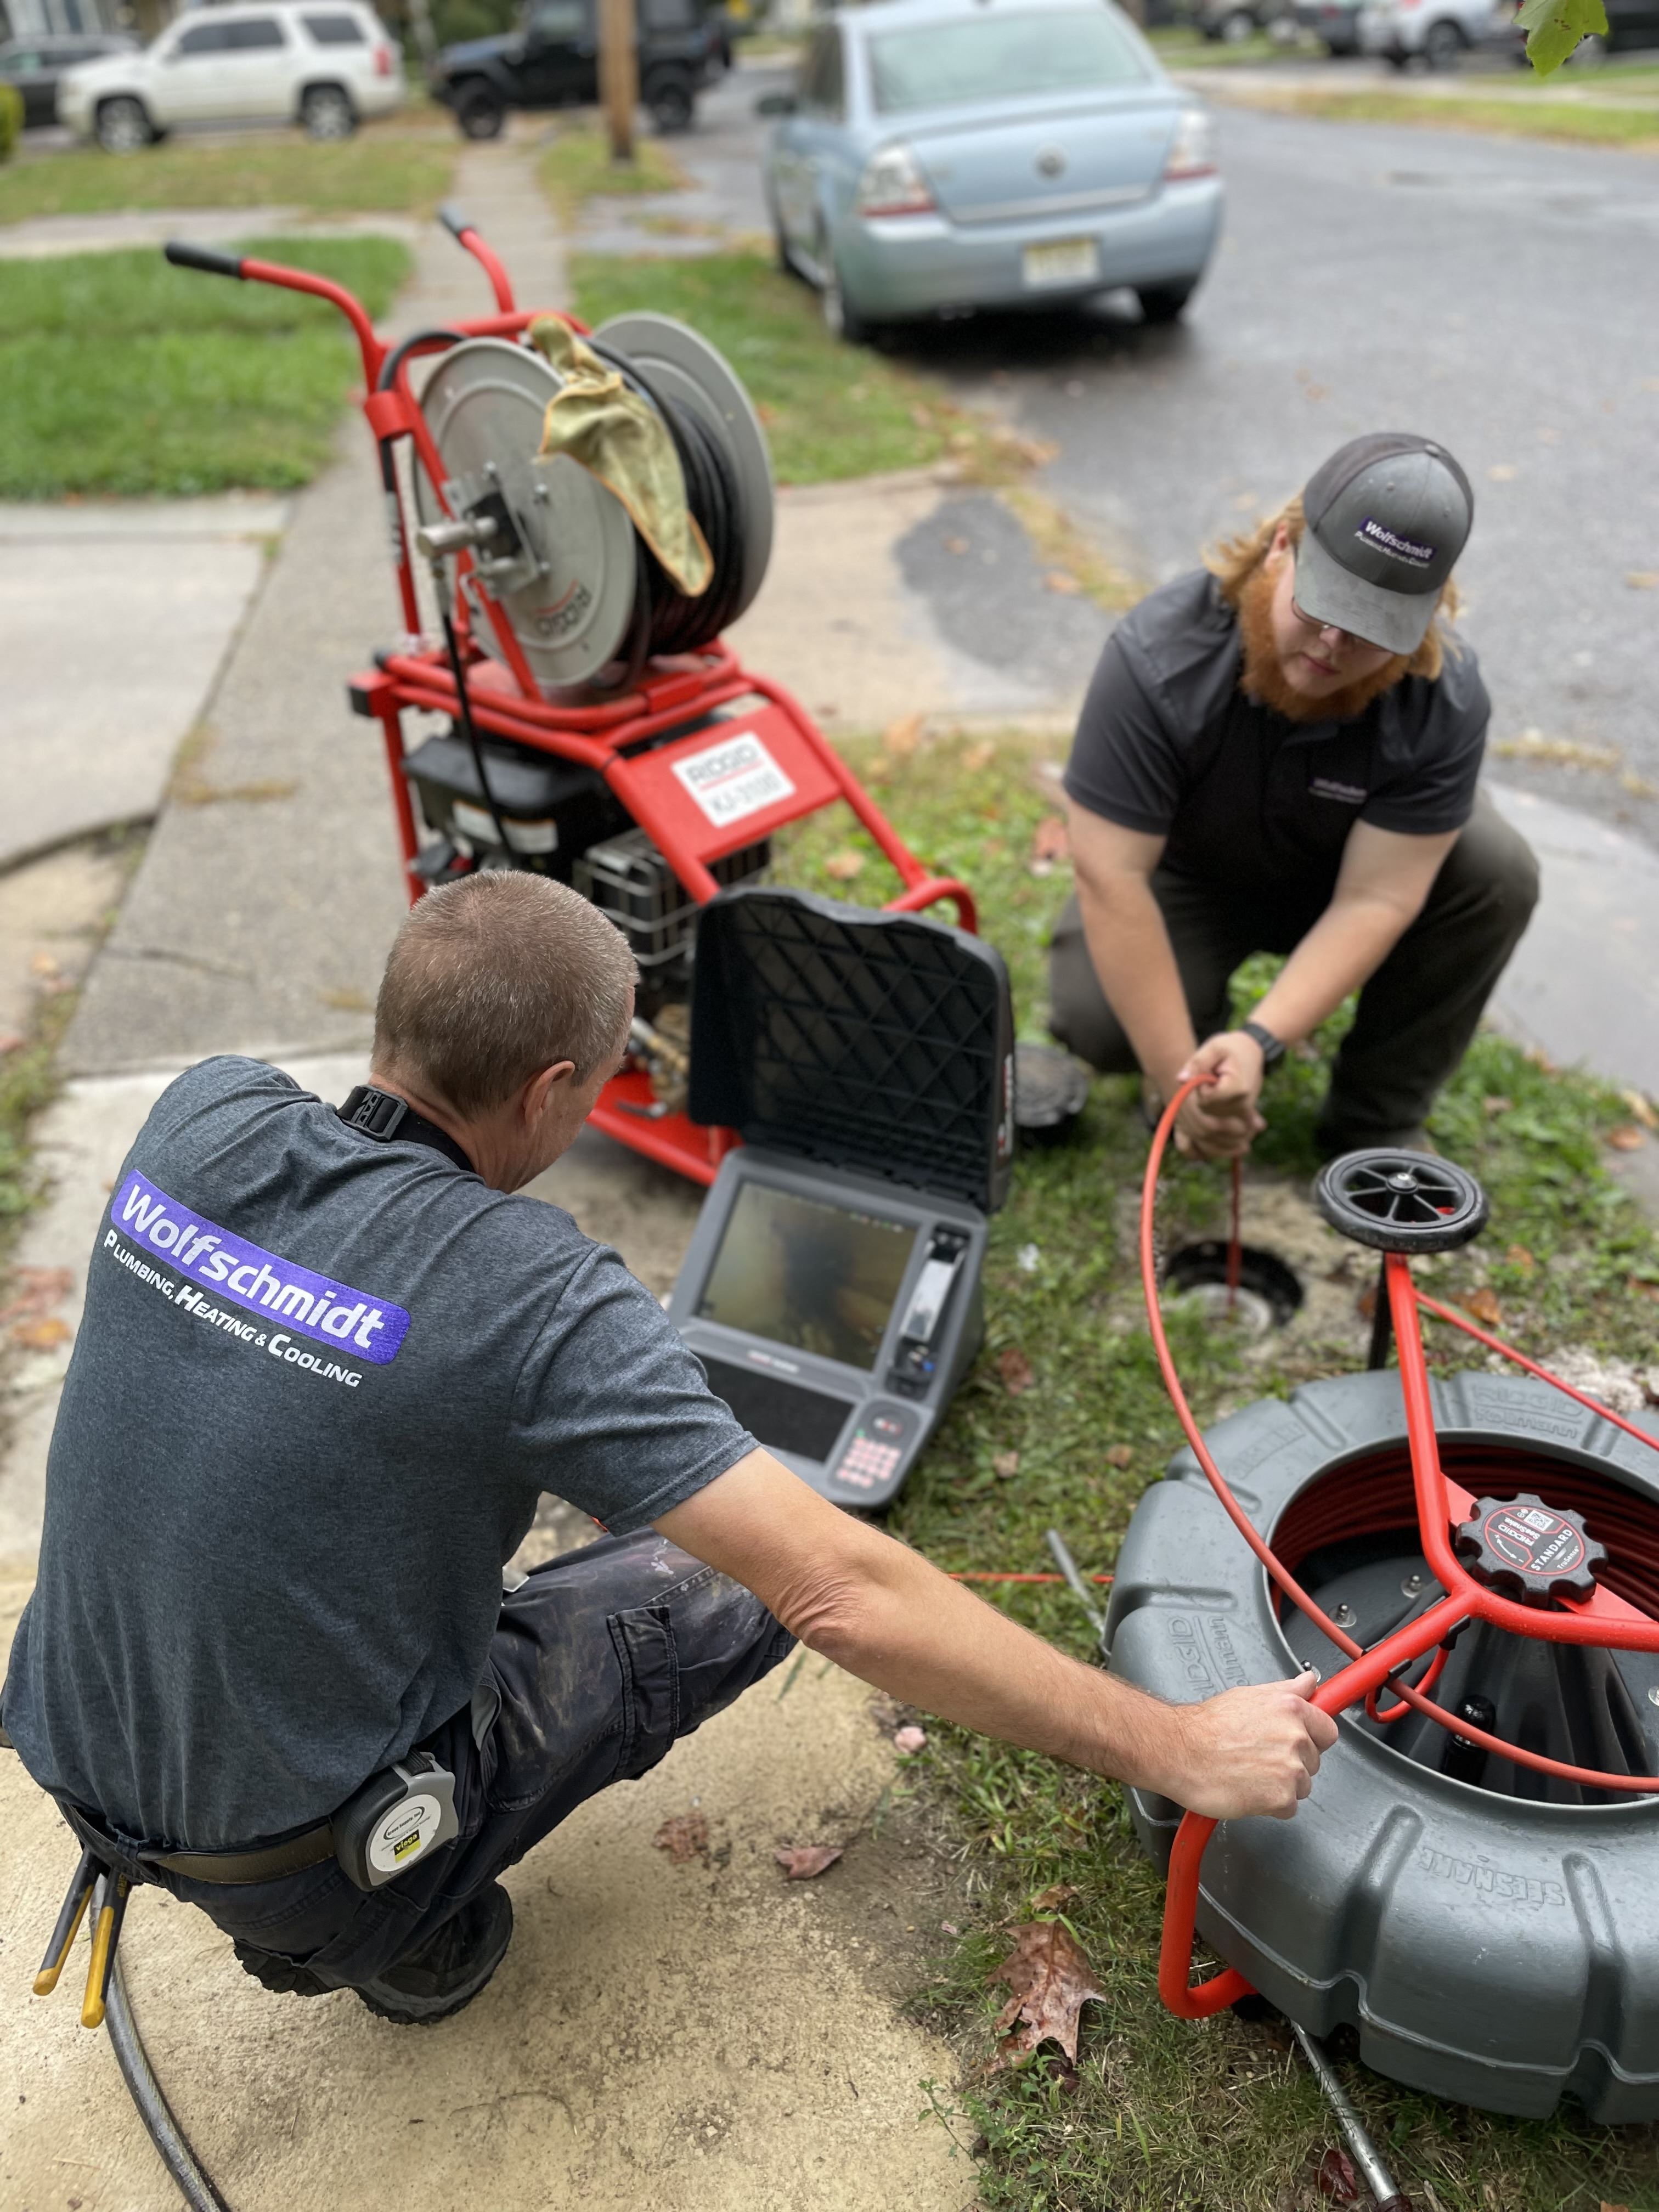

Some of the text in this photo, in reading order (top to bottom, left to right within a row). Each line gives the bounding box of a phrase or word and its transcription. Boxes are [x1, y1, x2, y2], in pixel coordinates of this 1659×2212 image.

[1364, 521, 1433, 559] Wolfschmidt
[121, 1184, 385, 1349] Wolfschmidt
[104, 1229, 363, 1387] PLUMBING, HEATING & COOLING
[1472, 1385, 1584, 1417] RIDGID
[1498, 1524, 1535, 1547] RIDGID
[1531, 1529, 1573, 1571] STANDARD
[1208, 1616, 1250, 1686] ollmann
[396, 1834, 417, 1851] viega
[1415, 1847, 1566, 1906] SEESNAKE
